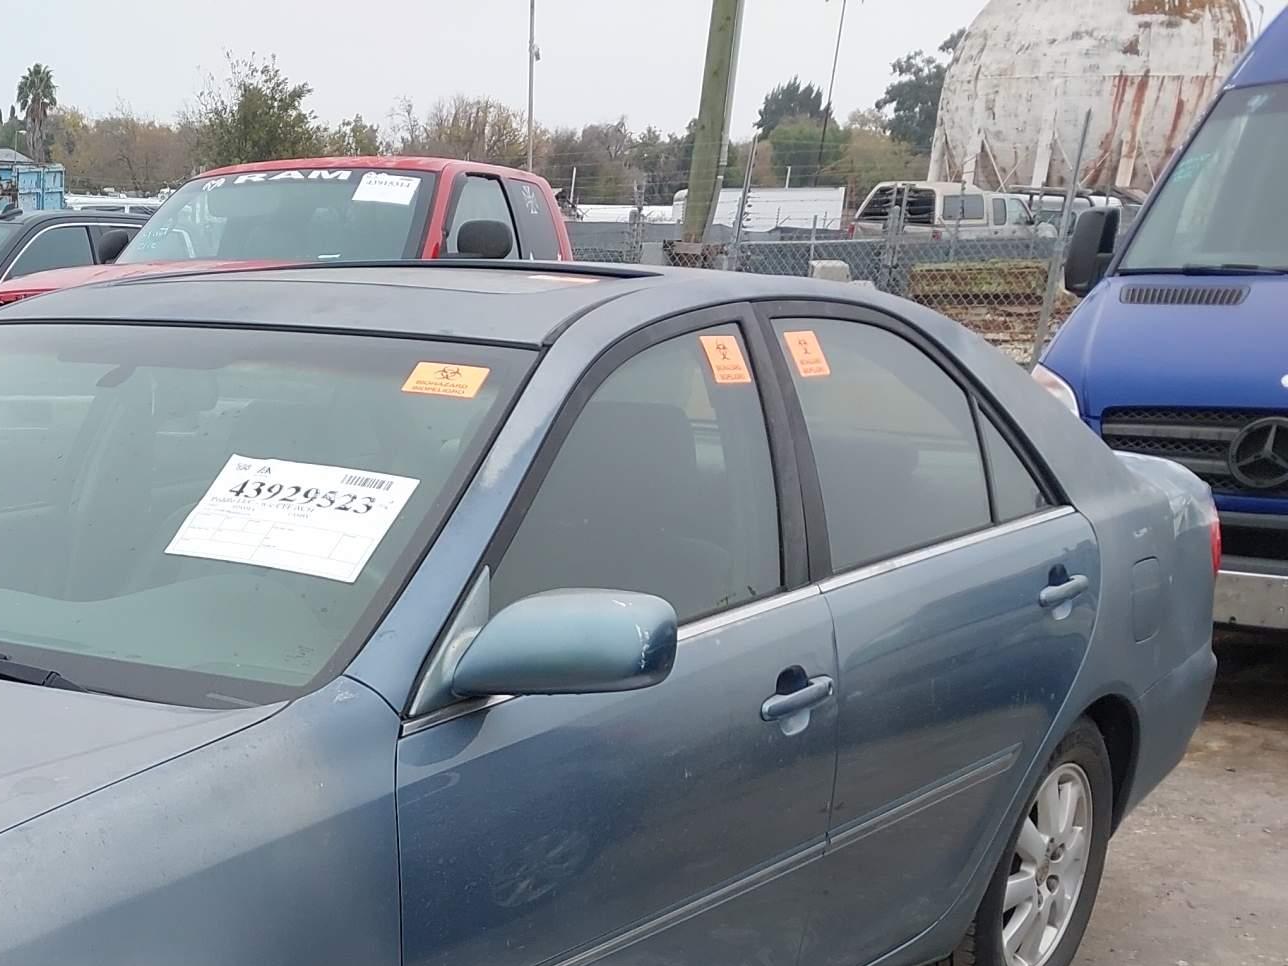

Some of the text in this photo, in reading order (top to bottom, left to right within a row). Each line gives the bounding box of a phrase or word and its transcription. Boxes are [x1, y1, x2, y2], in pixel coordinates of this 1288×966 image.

[233, 170, 353, 184] RAM
[415, 380, 469, 389] BIOHAZARD
[228, 479, 377, 514] 43929523
